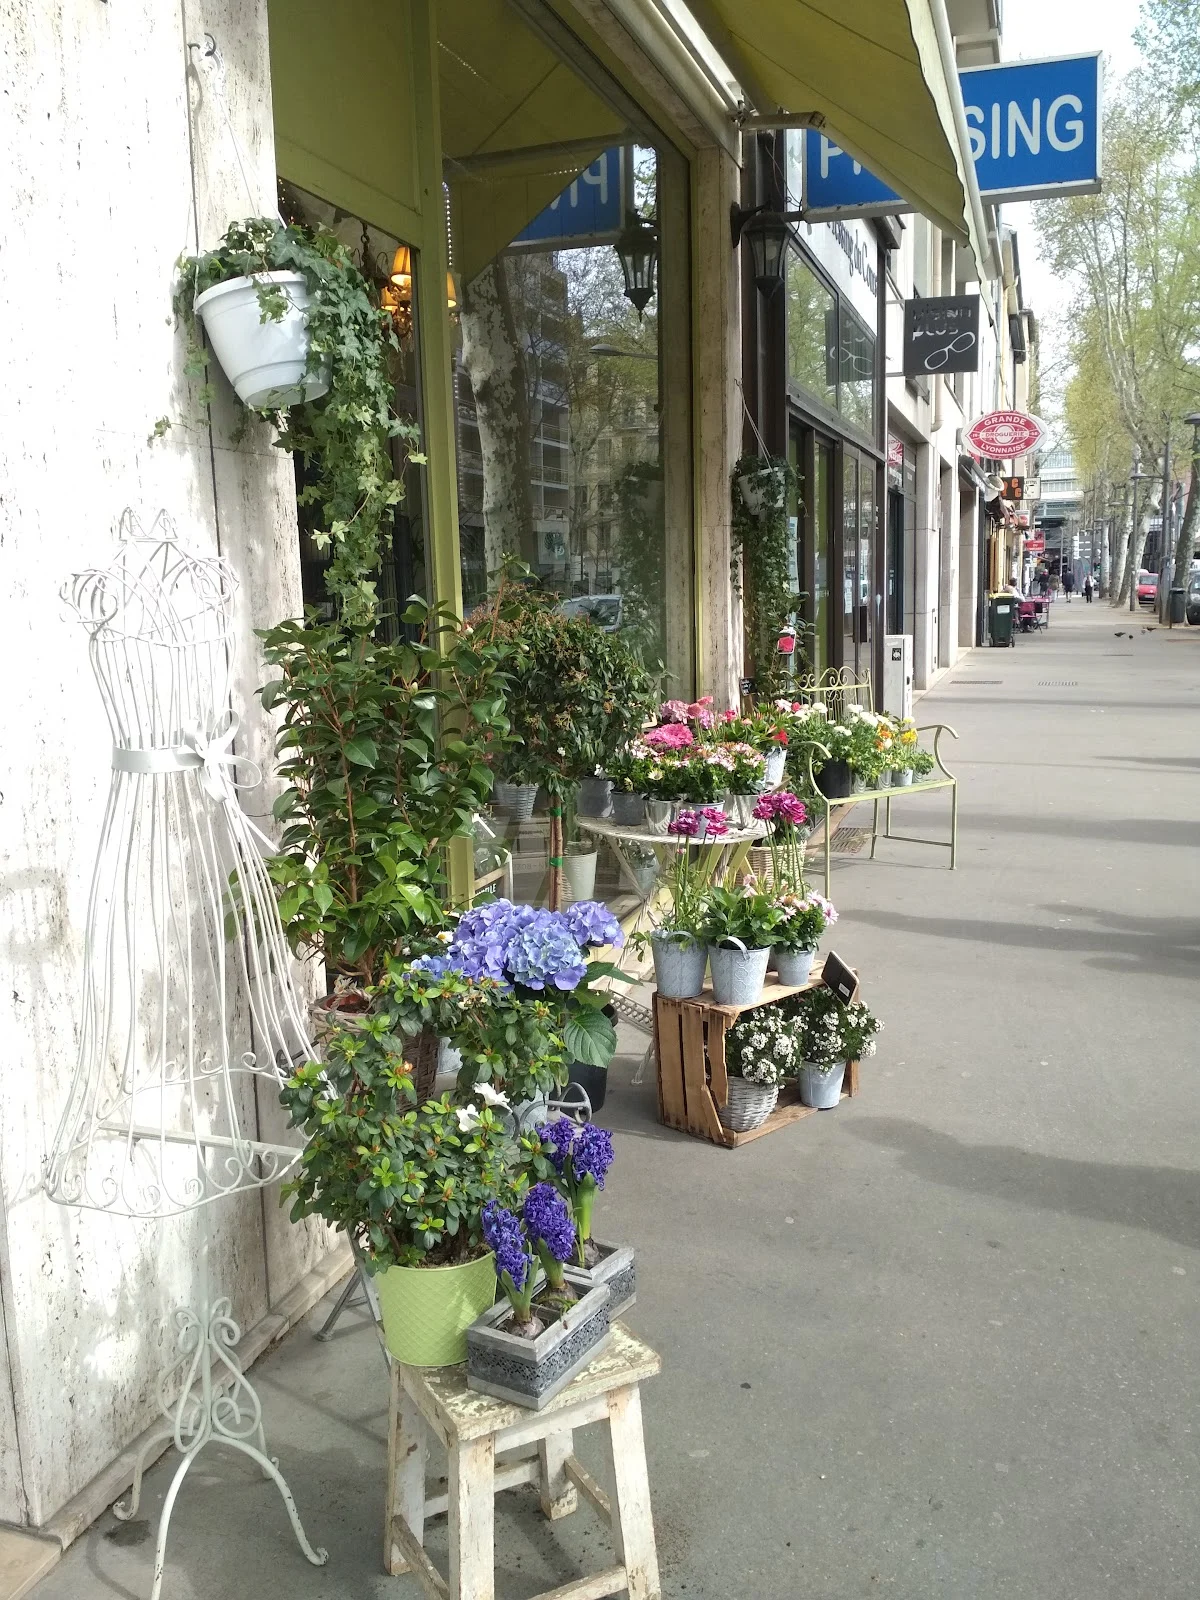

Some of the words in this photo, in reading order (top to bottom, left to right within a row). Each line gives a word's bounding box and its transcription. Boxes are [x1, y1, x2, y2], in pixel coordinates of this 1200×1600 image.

[820, 94, 1084, 179] PSING
[984, 416, 1027, 426] GRANDE
[981, 442, 1027, 454] LYONNAISE
